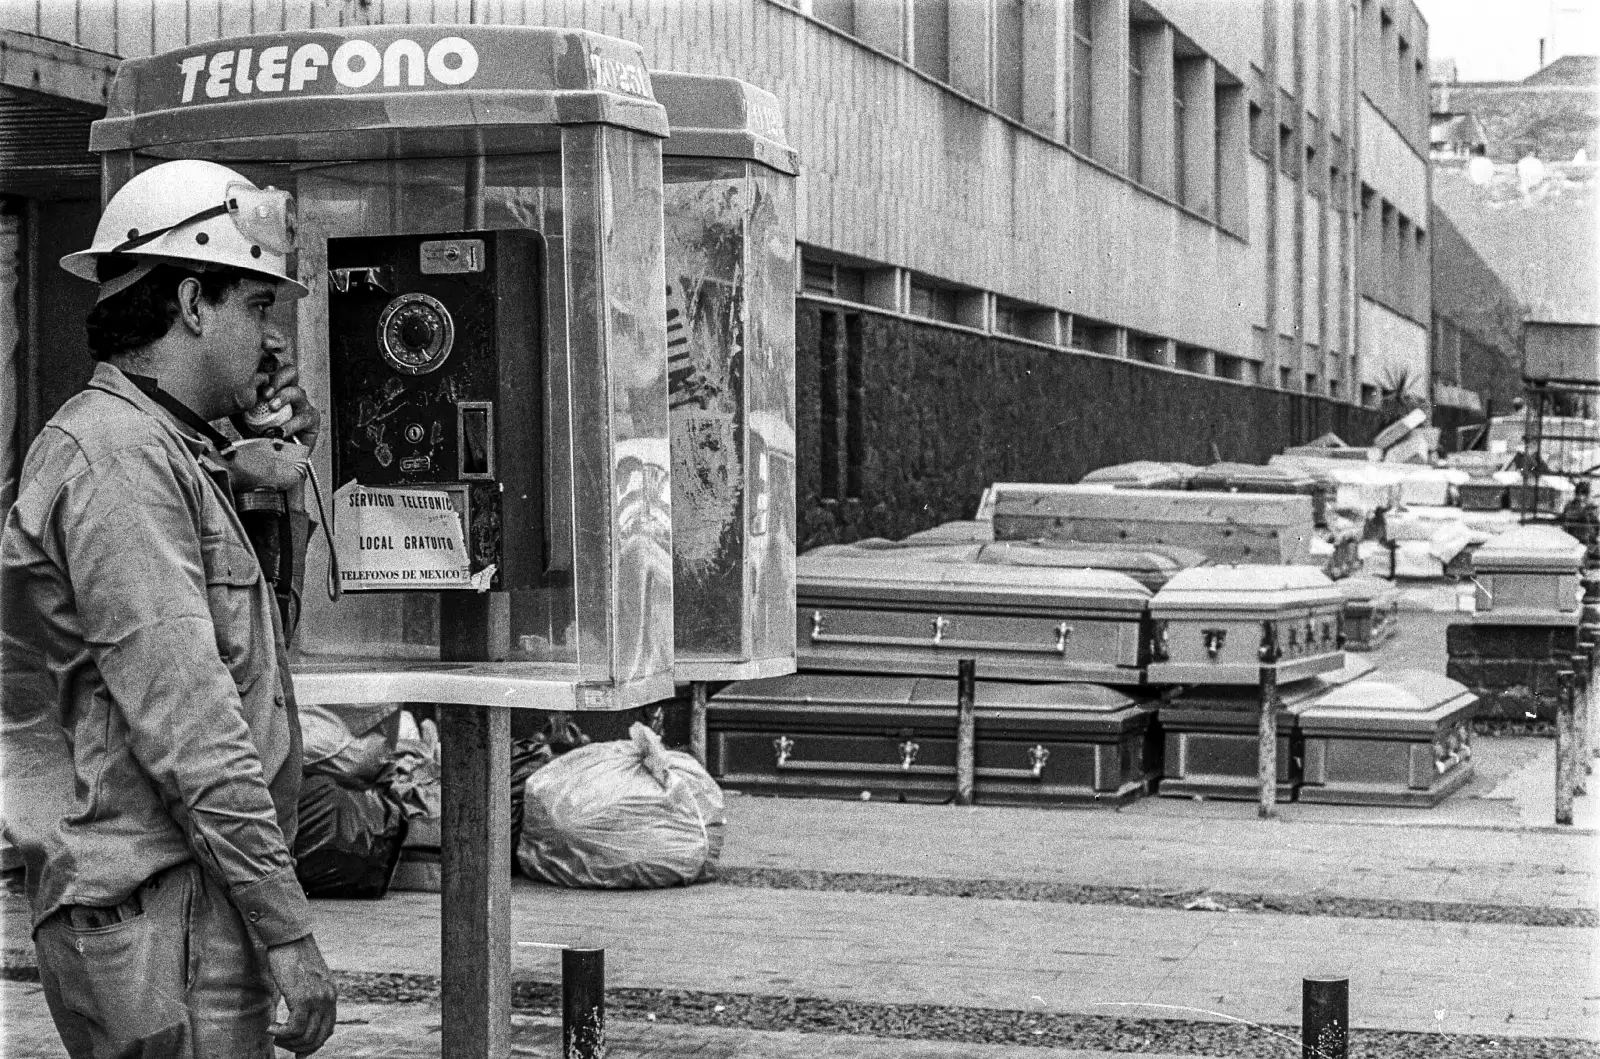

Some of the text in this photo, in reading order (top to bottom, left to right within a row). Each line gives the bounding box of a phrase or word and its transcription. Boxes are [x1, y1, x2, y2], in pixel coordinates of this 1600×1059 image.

[180, 36, 479, 103] TELEFONO
[349, 493, 452, 511] SERVICIO TELEFONIC
[359, 536, 454, 551] LOCAL GRATUITO
[341, 570, 400, 580] TELEFONOS
[402, 570, 417, 580] DE
[419, 570, 460, 580] MEXICO
